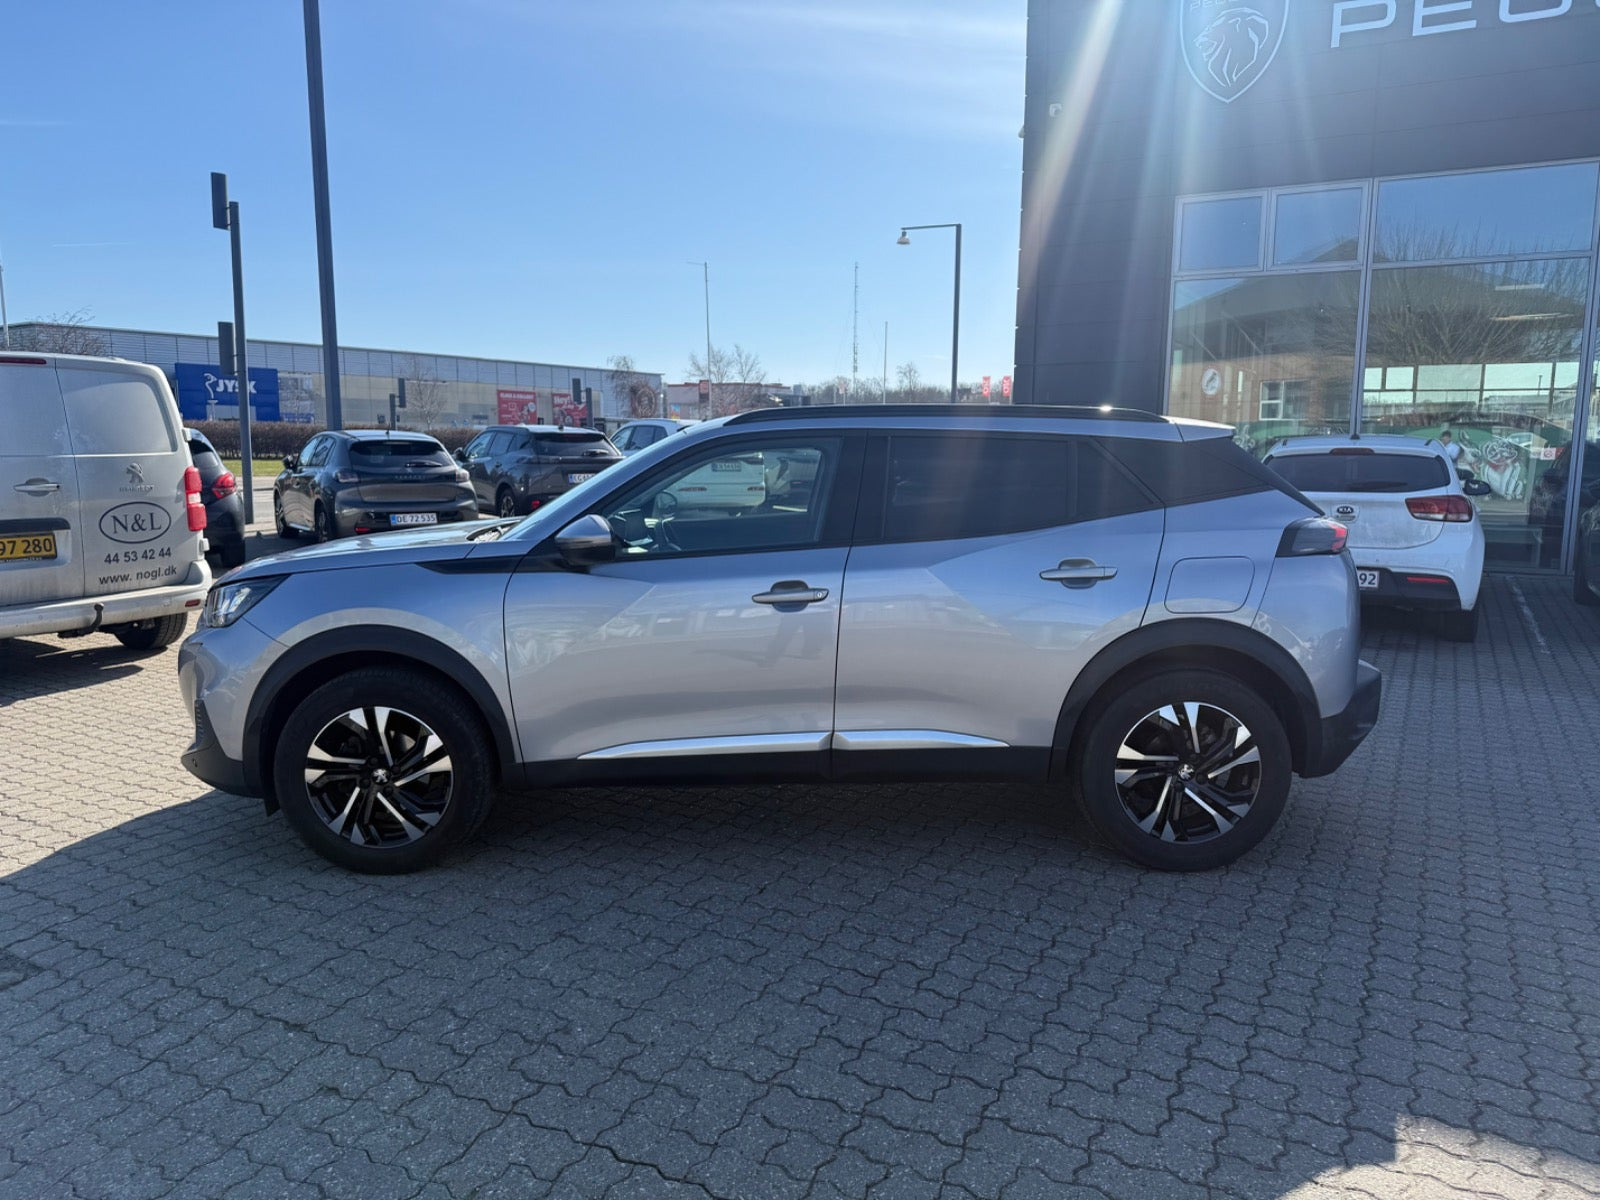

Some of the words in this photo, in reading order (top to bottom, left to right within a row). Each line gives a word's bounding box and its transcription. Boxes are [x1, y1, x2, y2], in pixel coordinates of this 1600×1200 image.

[1330, 0, 1600, 48] PEU
[110, 512, 162, 534] N&L
[409, 515, 419, 523] 72
[21, 538, 53, 554] 280
[104, 552, 120, 564] 44
[124, 550, 138, 563] 53
[141, 548, 155, 560] 42
[159, 546, 171, 557] 44
[99, 573, 132, 585] www.
[136, 565, 177, 580] nogl.dk
[1359, 572, 1376, 585] 92
